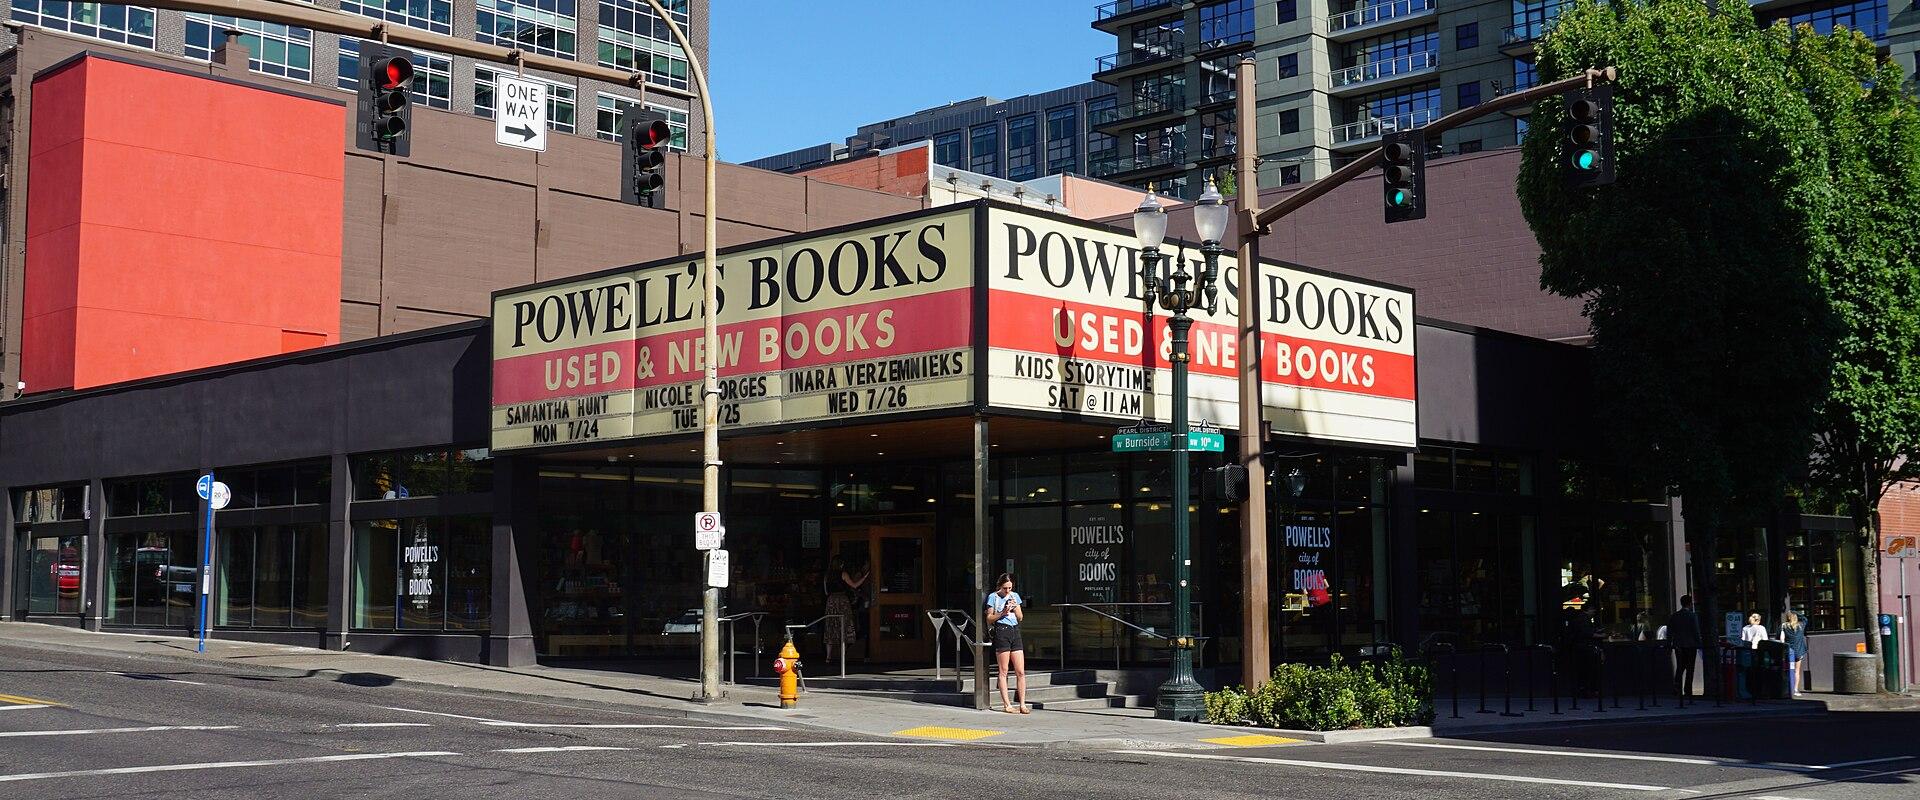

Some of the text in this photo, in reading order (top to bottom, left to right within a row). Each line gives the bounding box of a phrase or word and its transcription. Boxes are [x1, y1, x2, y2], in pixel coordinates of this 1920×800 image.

[507, 83, 538, 103] ONE
[506, 101, 539, 120] WAY
[748, 222, 947, 311] BOOKS
[1265, 274, 1402, 344] BOOKS
[545, 309, 894, 391] USED & NEW BOOKS
[1052, 307, 1143, 357] USED
[1277, 341, 1375, 388] BOOKS
[789, 352, 963, 391] INARA VERZEMNIEKS
[1014, 355, 1152, 392] KIDS STORYTIME
[645, 376, 767, 409] NICOLE ORGES
[827, 386, 907, 415] WED 7/26
[1048, 385, 1078, 409] SAT
[1086, 395, 1097, 411] @
[1119, 393, 1141, 415] AM
[507, 396, 609, 426] SAMANTHA HUNT
[673, 403, 740, 431] TUE /25
[533, 417, 598, 443] MON 7/24
[1125, 437, 1160, 448] Burnside
[1071, 525, 1124, 545] POWELL'S
[1286, 525, 1330, 548] POWELL'S
[404, 546, 439, 563] POWELL'S
[1084, 547, 1110, 560] city of
[1298, 552, 1320, 566] city of
[1080, 562, 1116, 582] BOOKS
[1294, 569, 1325, 590] BOOKS
[409, 578, 432, 596] BOOKS
